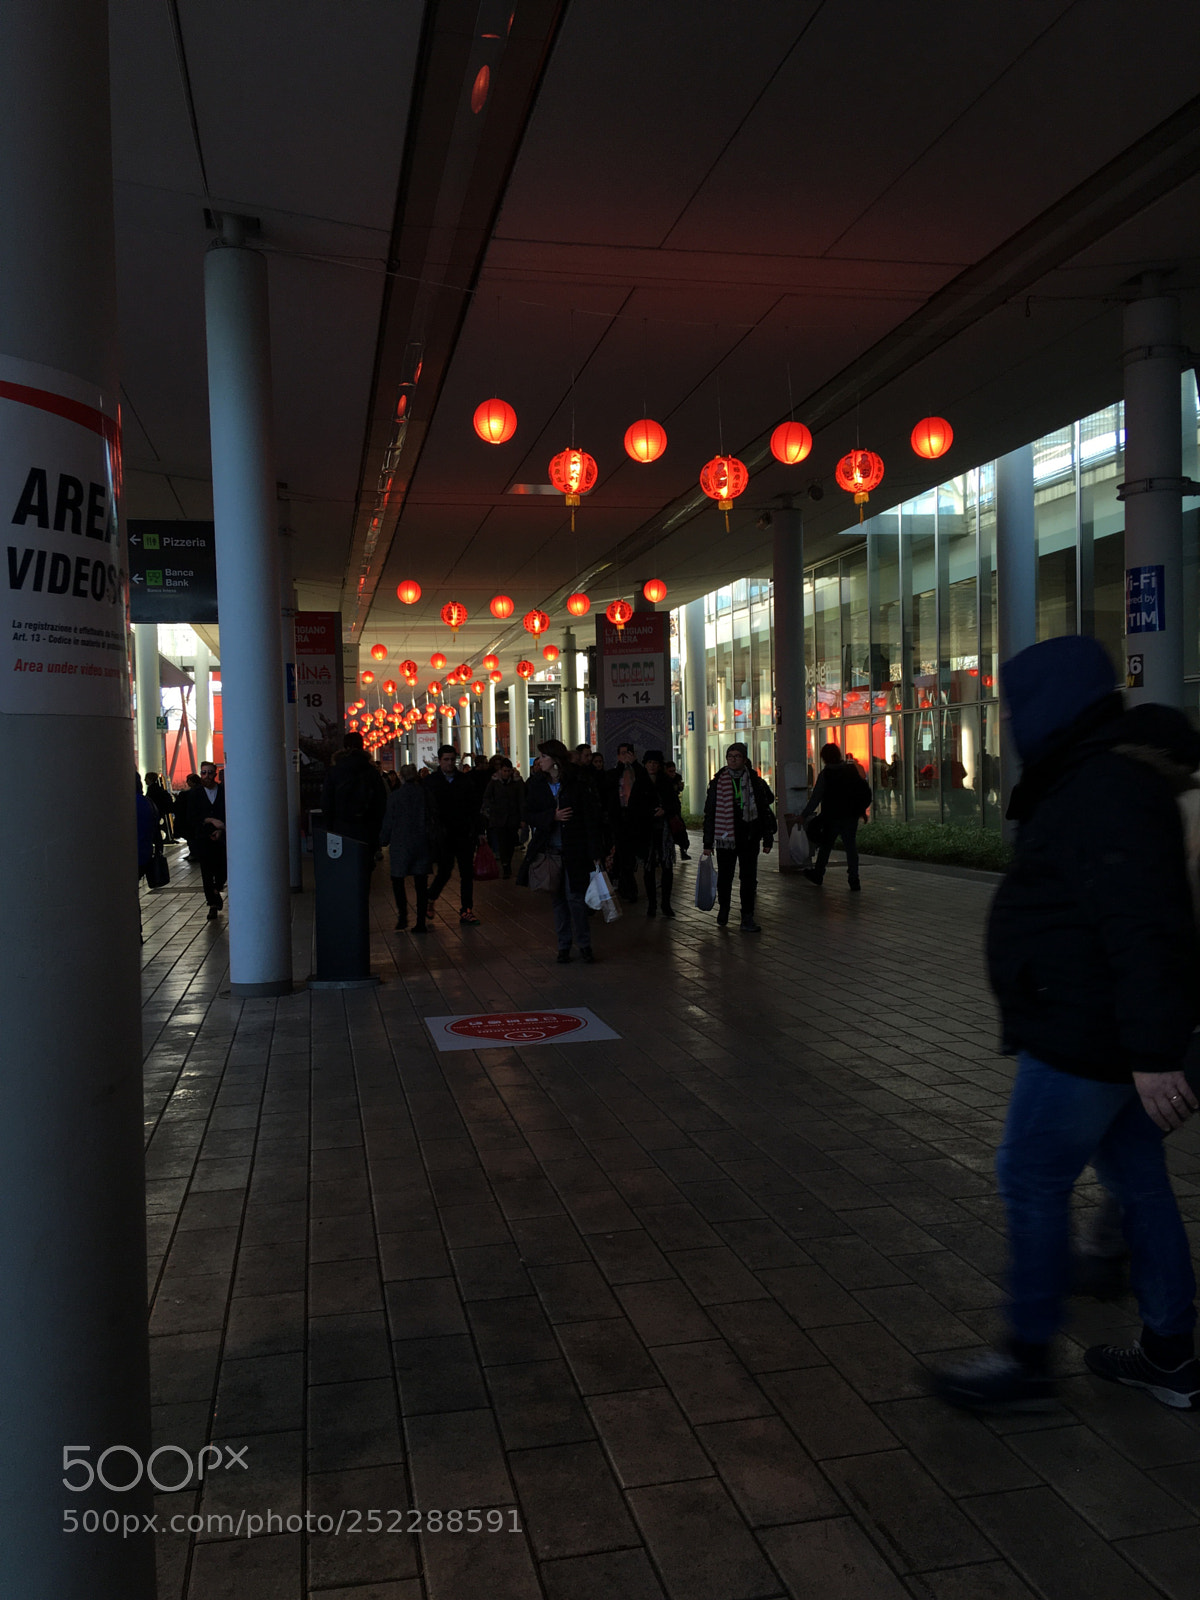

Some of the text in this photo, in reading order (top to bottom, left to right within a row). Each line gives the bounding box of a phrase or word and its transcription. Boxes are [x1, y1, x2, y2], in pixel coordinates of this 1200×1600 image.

[163, 537, 206, 547] Pizzeria
[165, 568, 194, 577] Banca
[165, 579, 189, 587] Bank
[1127, 572, 1156, 591] i-Fi
[1144, 593, 1155, 605] by
[1129, 611, 1156, 627] TIM
[13, 620, 22, 629] La
[25, 621, 72, 633] registrazione
[13, 632, 28, 642] Art.
[31, 633, 41, 642] 13
[48, 634, 71, 645] Codice
[605, 635, 638, 645] IN FERA
[14, 658, 43, 673] Area
[47, 662, 78, 674] under
[81, 663, 102, 677] video
[1127, 656, 1142, 675] 6
[304, 694, 322, 707] 18
[633, 690, 651, 704] 14
